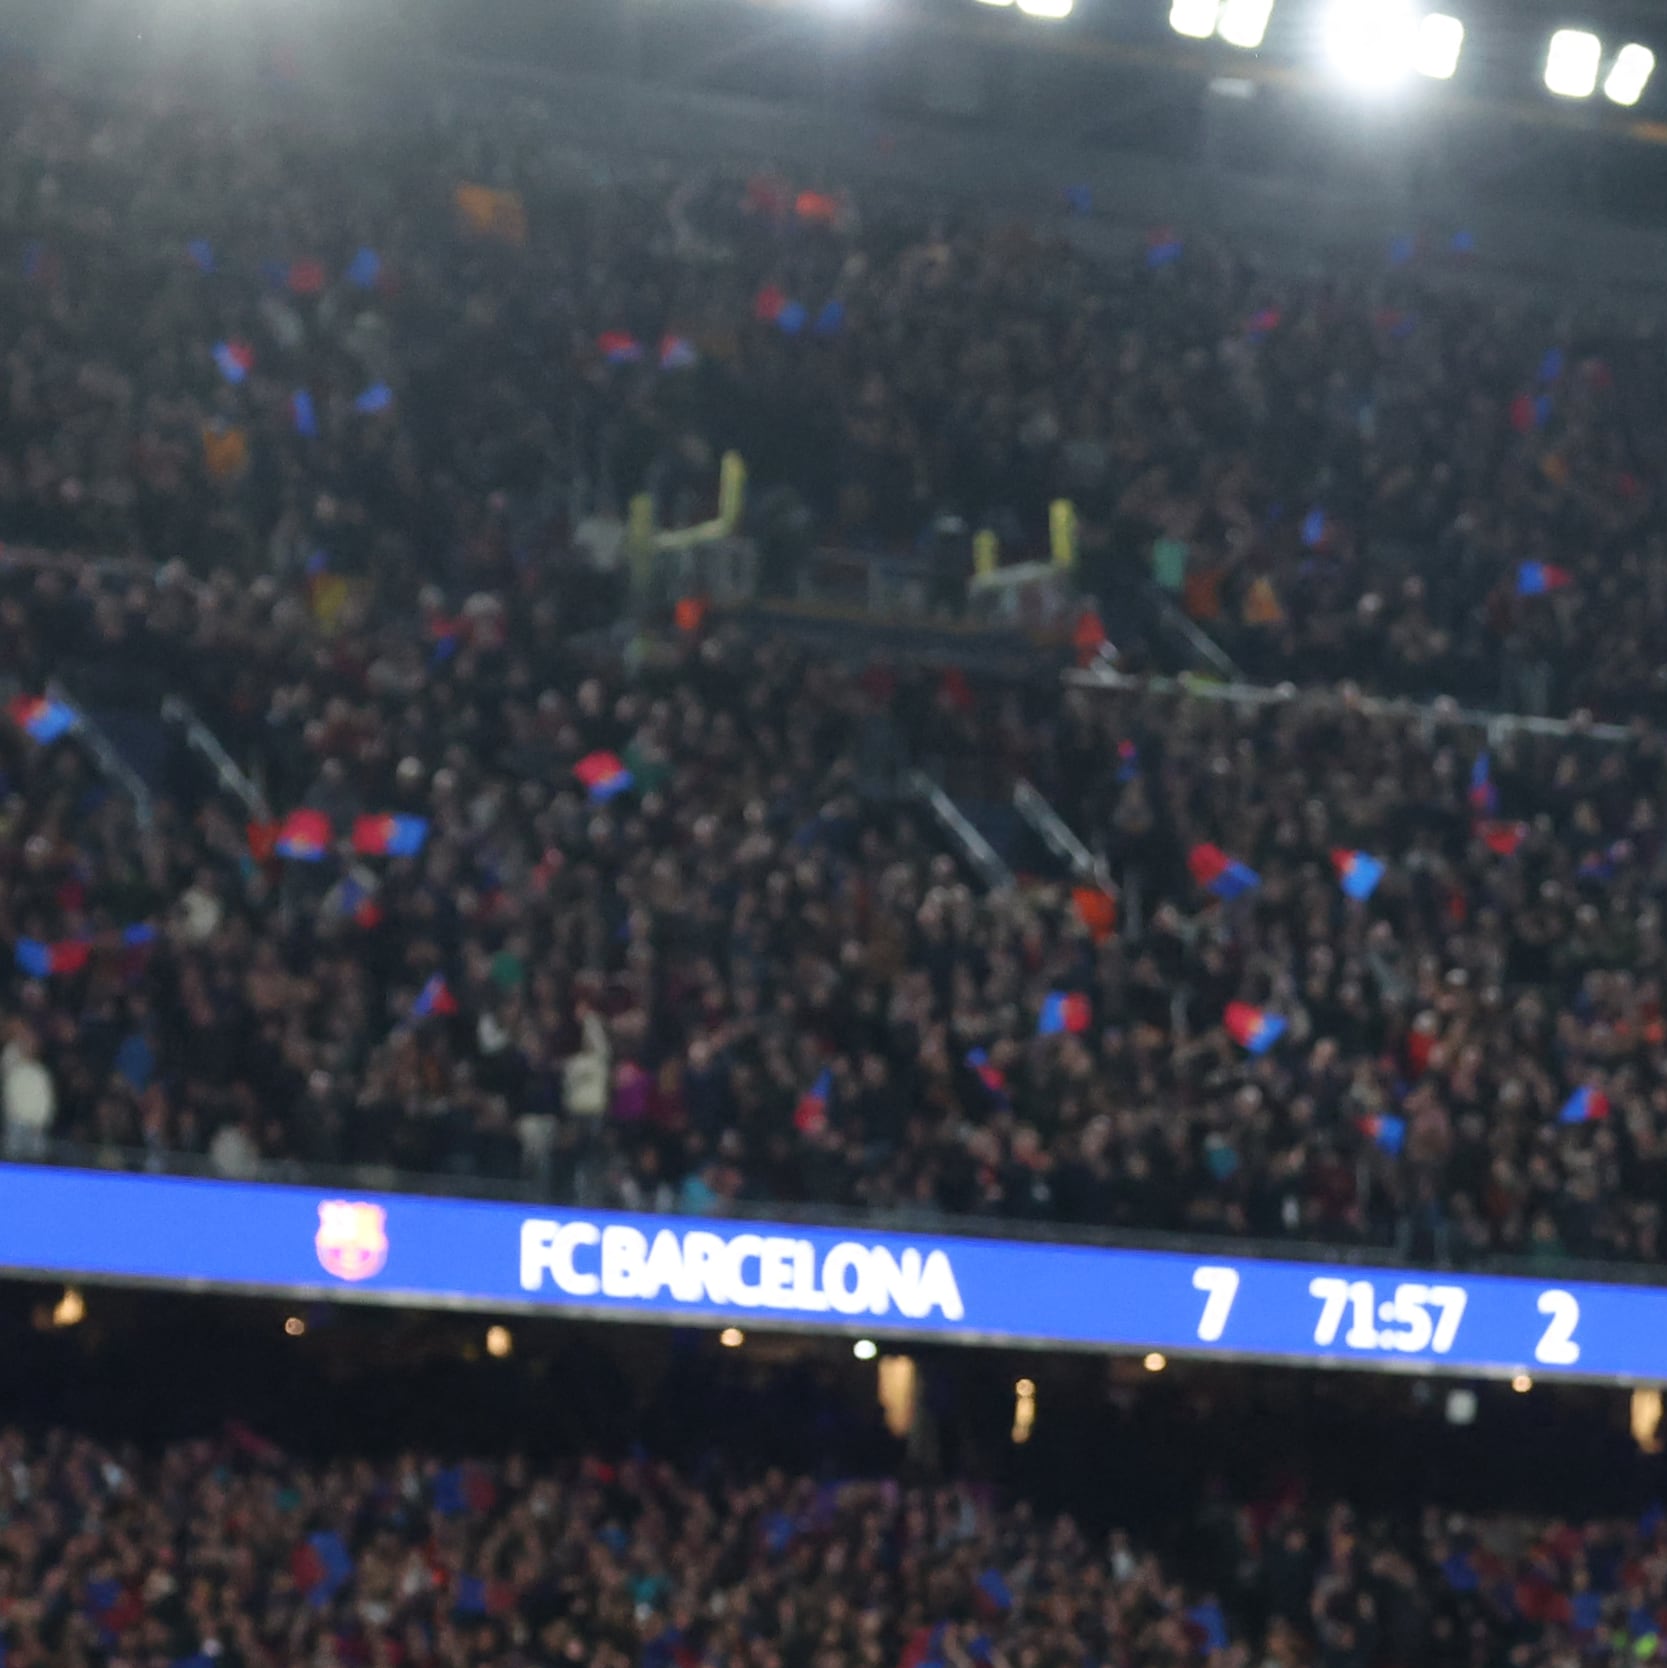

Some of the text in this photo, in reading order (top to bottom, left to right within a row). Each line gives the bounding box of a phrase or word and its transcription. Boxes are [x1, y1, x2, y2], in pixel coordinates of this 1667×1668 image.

[521, 1219, 963, 1320] FC BARCELONA
[1193, 1267, 1238, 1341] 7
[1310, 1277, 1467, 1354] 71:57
[1537, 1290, 1580, 1366] 2
